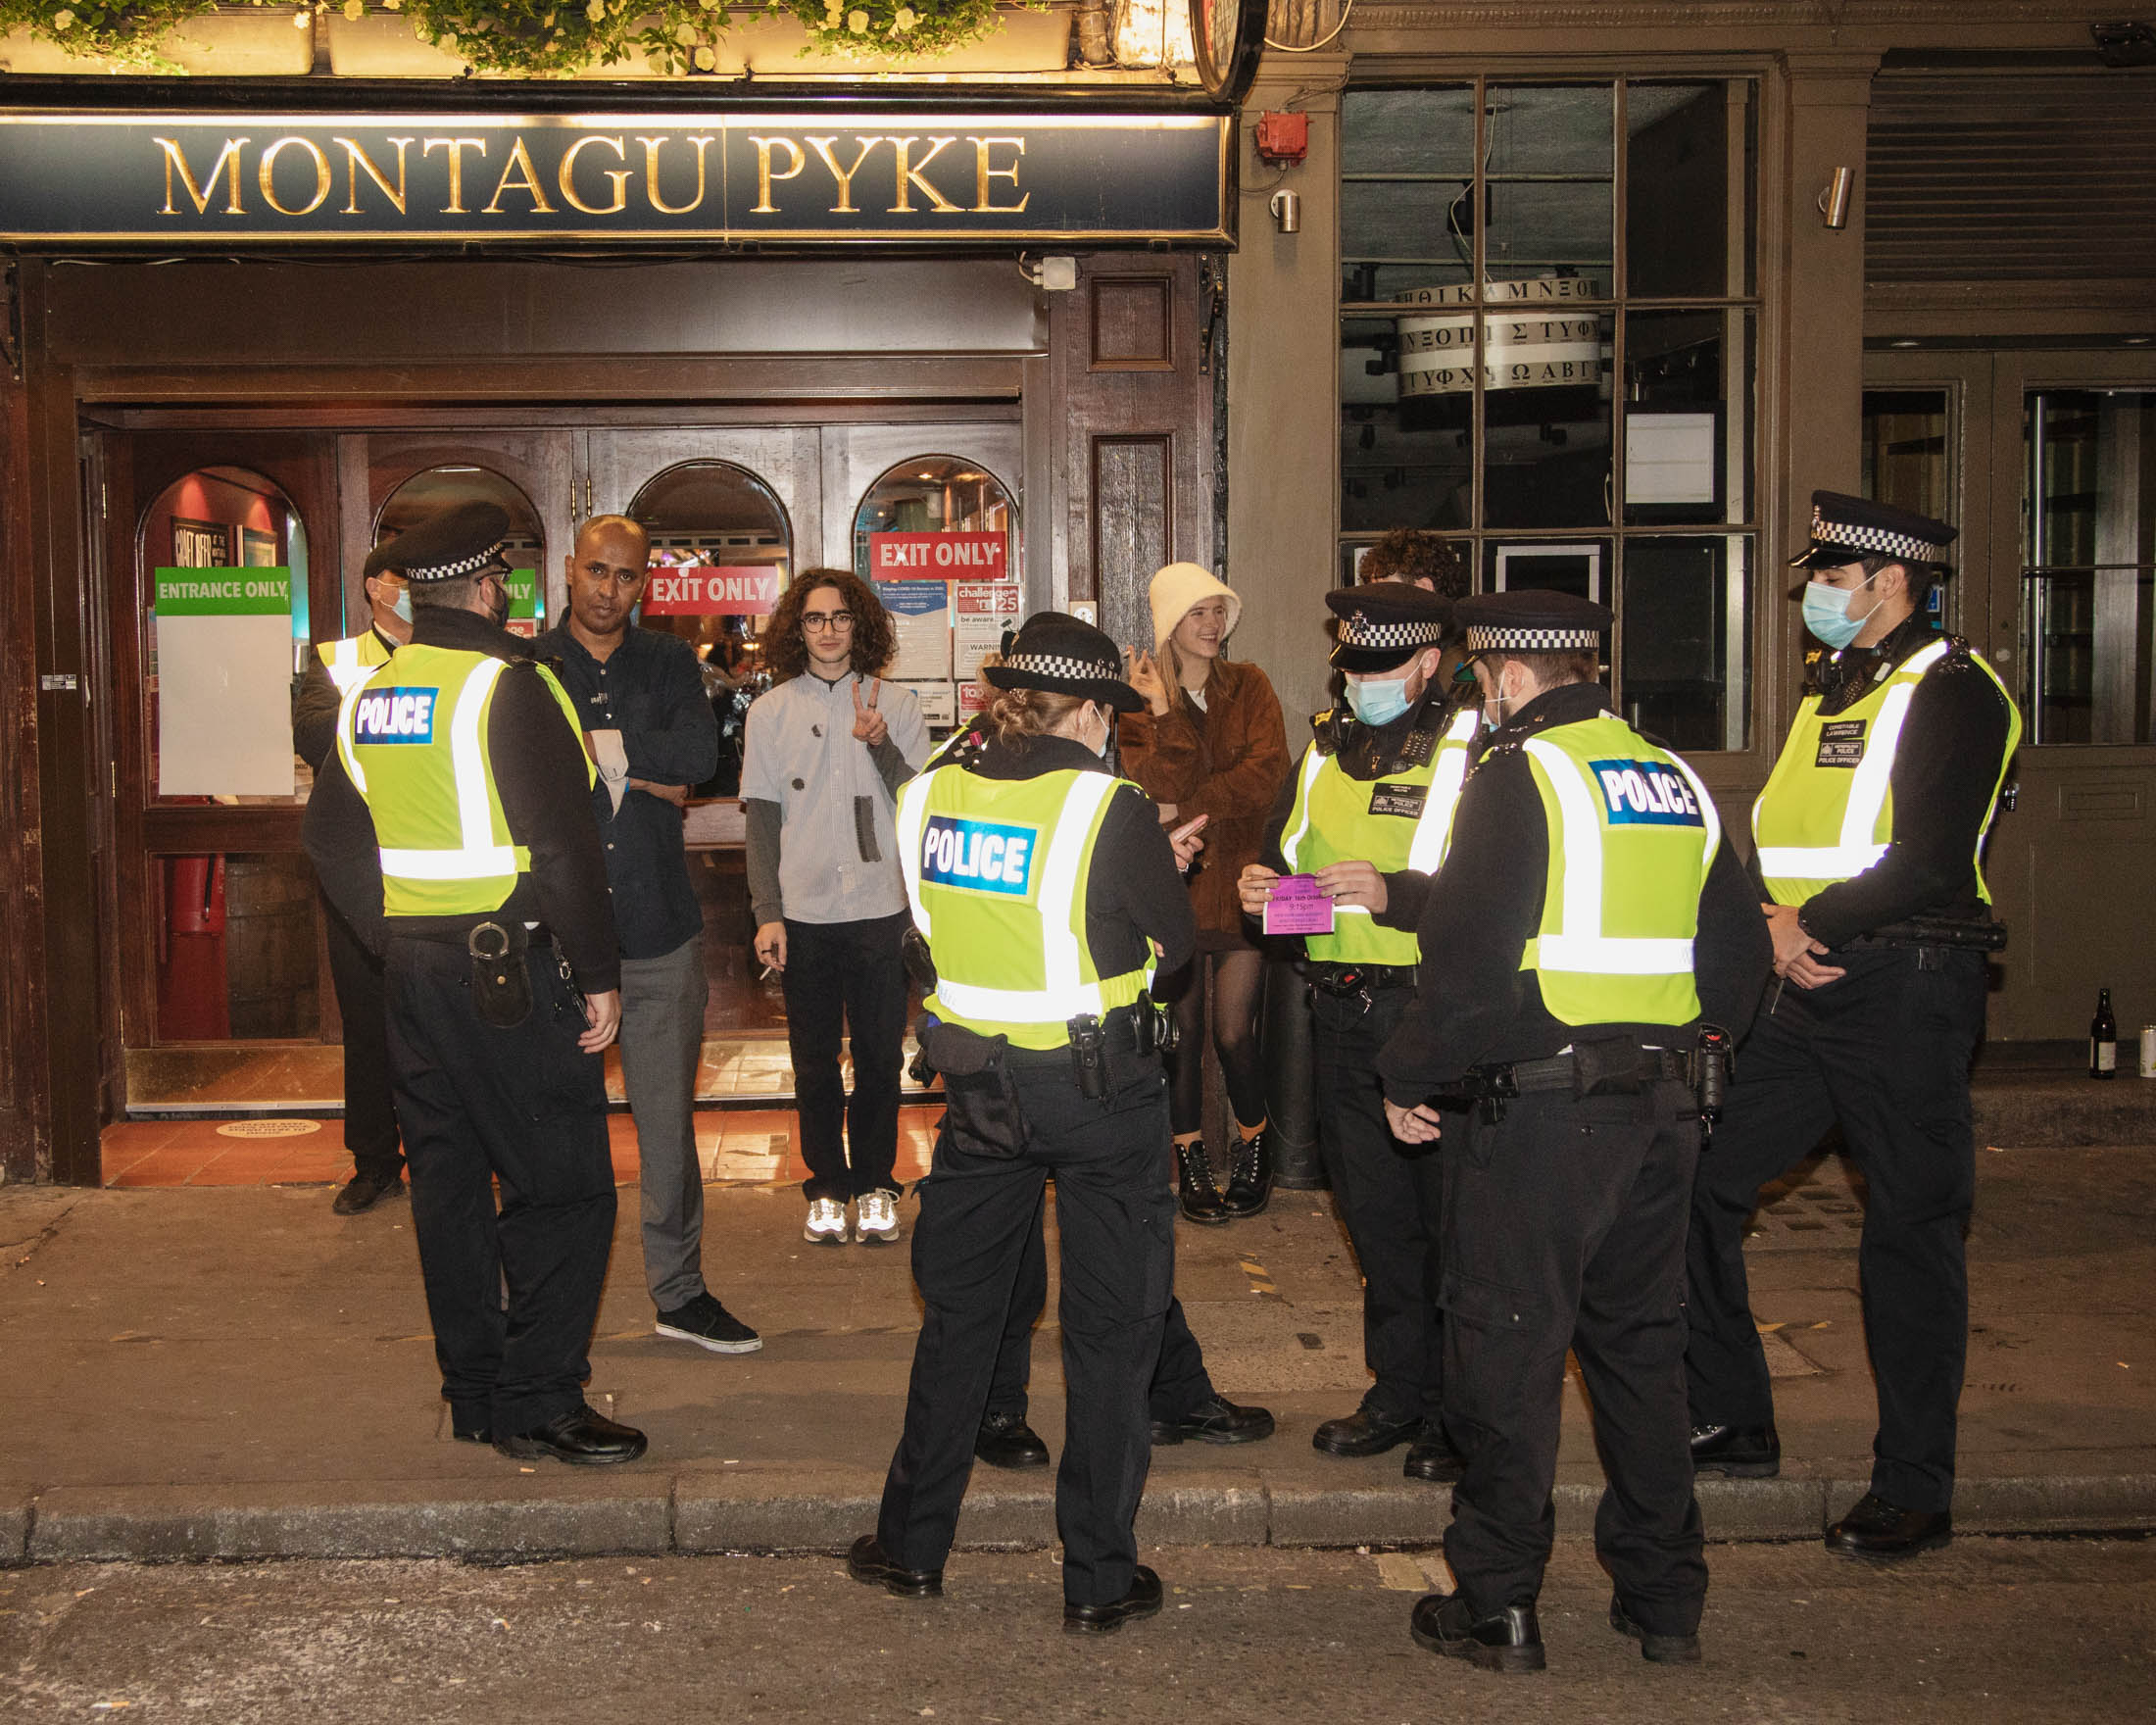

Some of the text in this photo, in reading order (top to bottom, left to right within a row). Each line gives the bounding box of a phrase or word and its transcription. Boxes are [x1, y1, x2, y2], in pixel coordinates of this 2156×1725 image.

[152, 134, 1030, 216] MONTAGU PYKE
[880, 542, 998, 567] EXIT ONLY
[159, 580, 288, 599] ENTRANCE ONLY
[504, 583, 531, 600] NLY
[653, 577, 770, 602] EXIT ONLY
[996, 597, 1017, 612] 25
[357, 695, 432, 735] POLICE
[1599, 769, 1698, 815] POLICE
[923, 826, 1028, 884] POLICE
